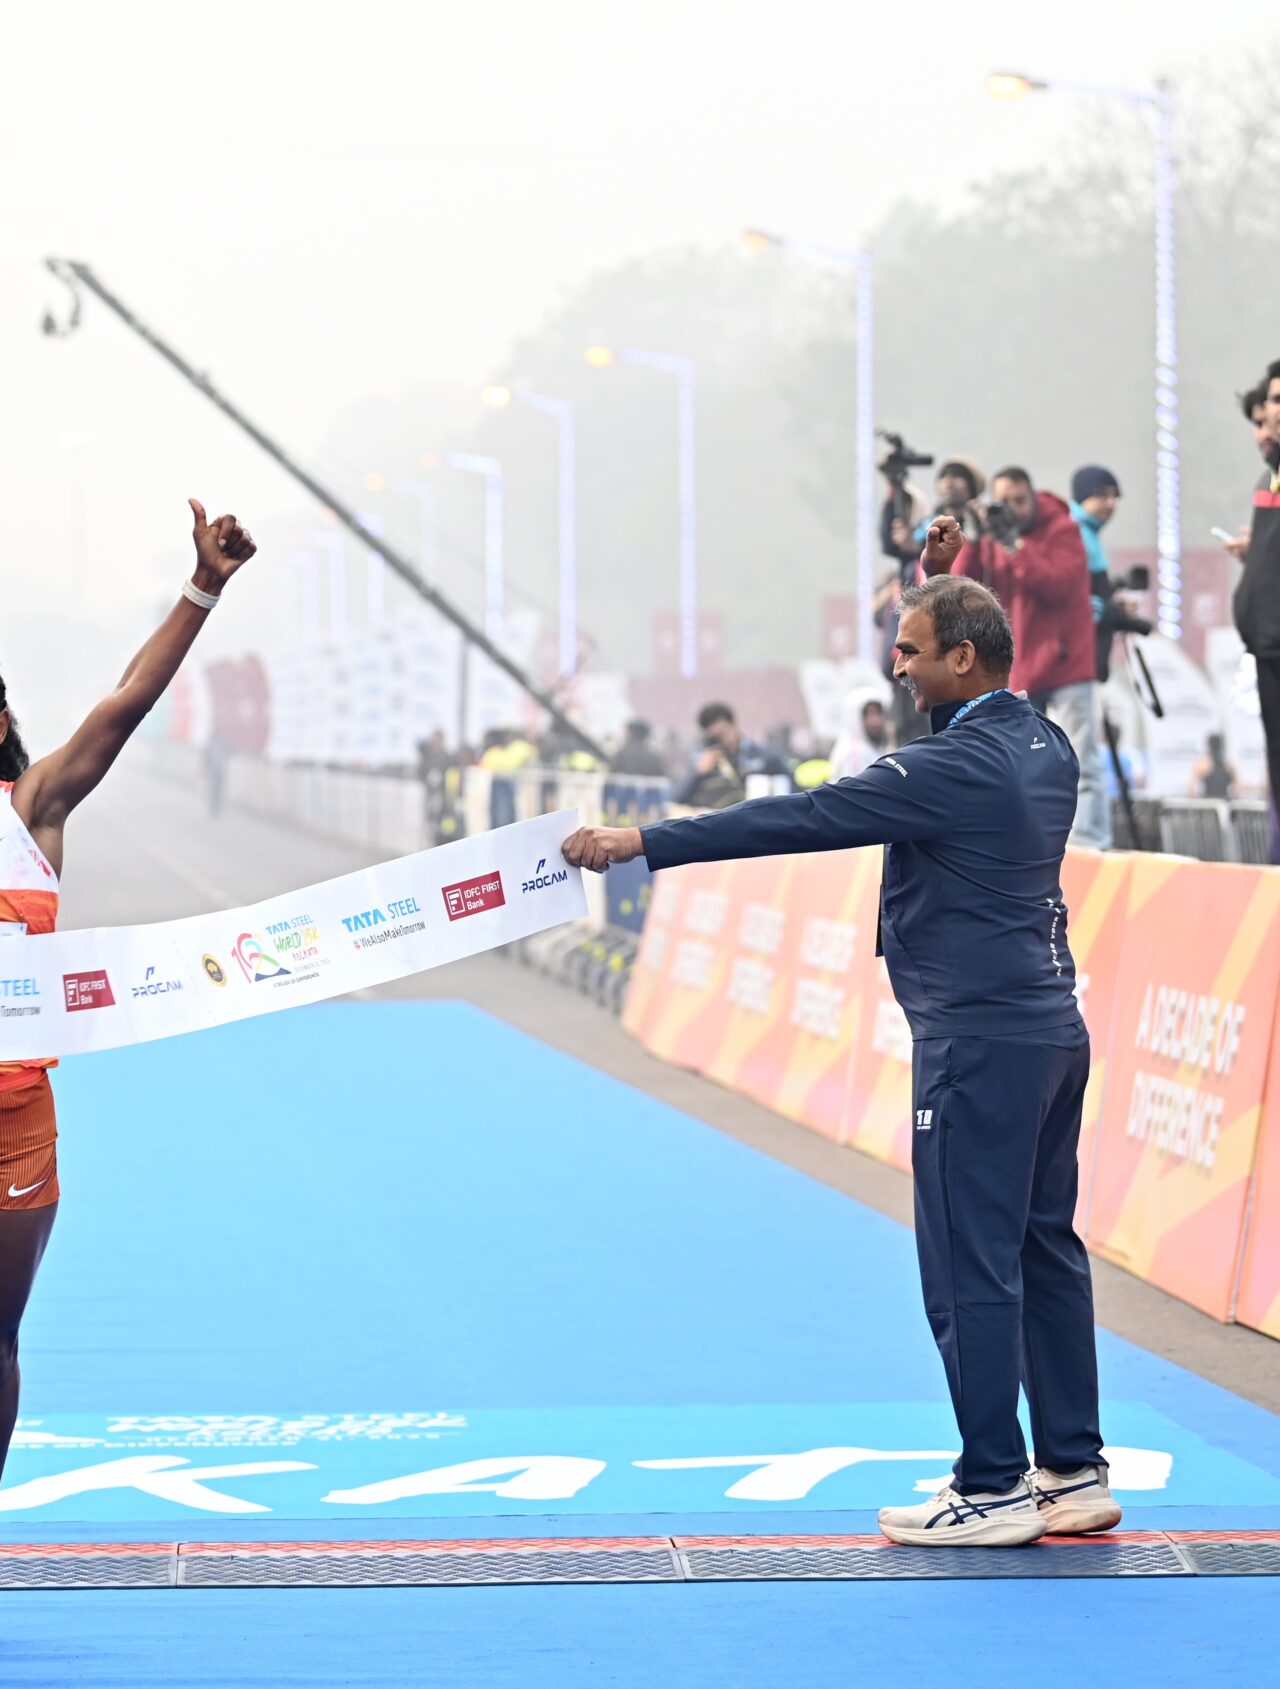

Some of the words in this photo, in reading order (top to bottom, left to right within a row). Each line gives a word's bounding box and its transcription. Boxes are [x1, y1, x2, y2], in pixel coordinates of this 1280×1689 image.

[464, 887, 481, 900] IDFC
[481, 879, 500, 893] FIRST
[521, 870, 568, 894] PROCAM
[341, 908, 387, 933] TATA
[387, 897, 421, 920] STEEL
[467, 900, 485, 911] Bank
[265, 920, 291, 936] TATA
[290, 914, 314, 929] STEEL
[273, 931, 302, 953] WORLD
[132, 980, 183, 998] PROCAM
[1135, 983, 1154, 1048] A
[1150, 986, 1220, 1070] DECADE
[1215, 1002, 1246, 1075] OF
[1127, 1070, 1225, 1168] DIFFERENCE
